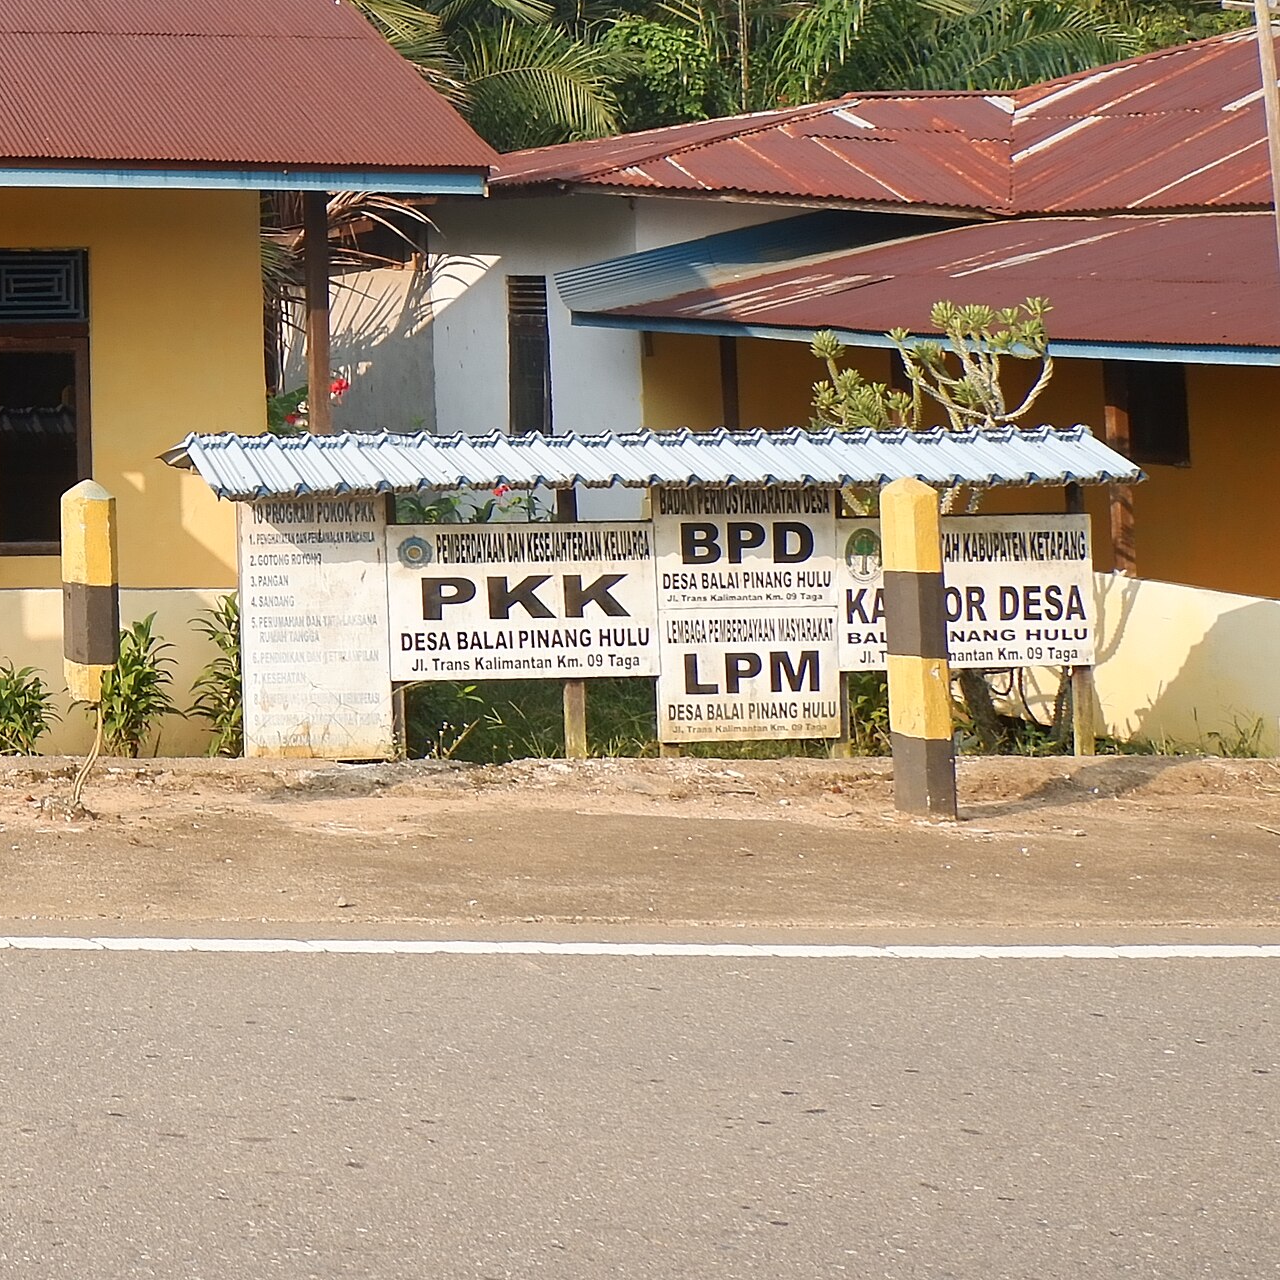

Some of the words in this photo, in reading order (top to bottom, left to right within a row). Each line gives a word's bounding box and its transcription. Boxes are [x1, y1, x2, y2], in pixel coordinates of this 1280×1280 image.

[660, 487, 695, 515] BADAN
[697, 487, 802, 514] PERMUSYAWARATAN
[804, 488, 830, 514] DESA
[265, 502, 314, 524] PROGRAM
[317, 502, 352, 523] POKOK
[355, 502, 375, 523] PKK
[436, 533, 505, 564] PEMBERDAYAAN
[507, 533, 525, 563] DAN
[527, 531, 602, 563] KESEJAHTERAAN
[603, 530, 651, 561] KELUARGA
[680, 522, 814, 564] BPD
[963, 532, 1027, 562] KABUPATEN
[1030, 531, 1086, 561] KETAPANG
[250, 555, 257, 566] 2.
[258, 554, 289, 566] GOTONG
[250, 576, 257, 587] 3.
[258, 575, 289, 587] PANGAN
[663, 573, 698, 589] DESA
[701, 572, 739, 589] BALAI
[744, 572, 791, 588] PINANG
[797, 571, 831, 588] HULU
[251, 597, 258, 608] 4.
[259, 596, 294, 608] SANDANG
[421, 573, 631, 620] PKK
[800, 593, 822, 601] Taga
[846, 586, 988, 624] KAOR
[1000, 584, 1086, 621] DESA
[251, 617, 257, 629] 5.
[306, 615, 321, 627] DAN
[667, 620, 706, 644] LEMBAGA
[709, 619, 775, 643] PEMBERDAYAAN
[778, 618, 833, 642] MASYARAKAT
[259, 631, 287, 643] RUMAH
[290, 630, 319, 643] TANGGA
[401, 632, 451, 652] DESA
[457, 630, 513, 650] BALAI
[519, 628, 591, 649] PINANG
[599, 627, 649, 647] HULU
[950, 629, 1016, 642] NANG
[1025, 628, 1087, 641] HULU
[411, 658, 428, 672] Jl.
[432, 658, 470, 671] Trans
[475, 656, 552, 670] Kalimantan
[557, 655, 583, 668] Km.
[587, 654, 603, 667] 09
[608, 654, 640, 670] Taga
[860, 650, 875, 664] Jl.
[998, 648, 1023, 661] Km.
[1027, 647, 1043, 660] 09
[1049, 647, 1078, 663] Taga
[684, 650, 820, 695] LPM
[669, 704, 703, 721] DESA
[707, 703, 744, 720] BALAI
[749, 702, 798, 719] PINANG
[803, 701, 836, 718] HULU
[687, 725, 712, 733] Trans
